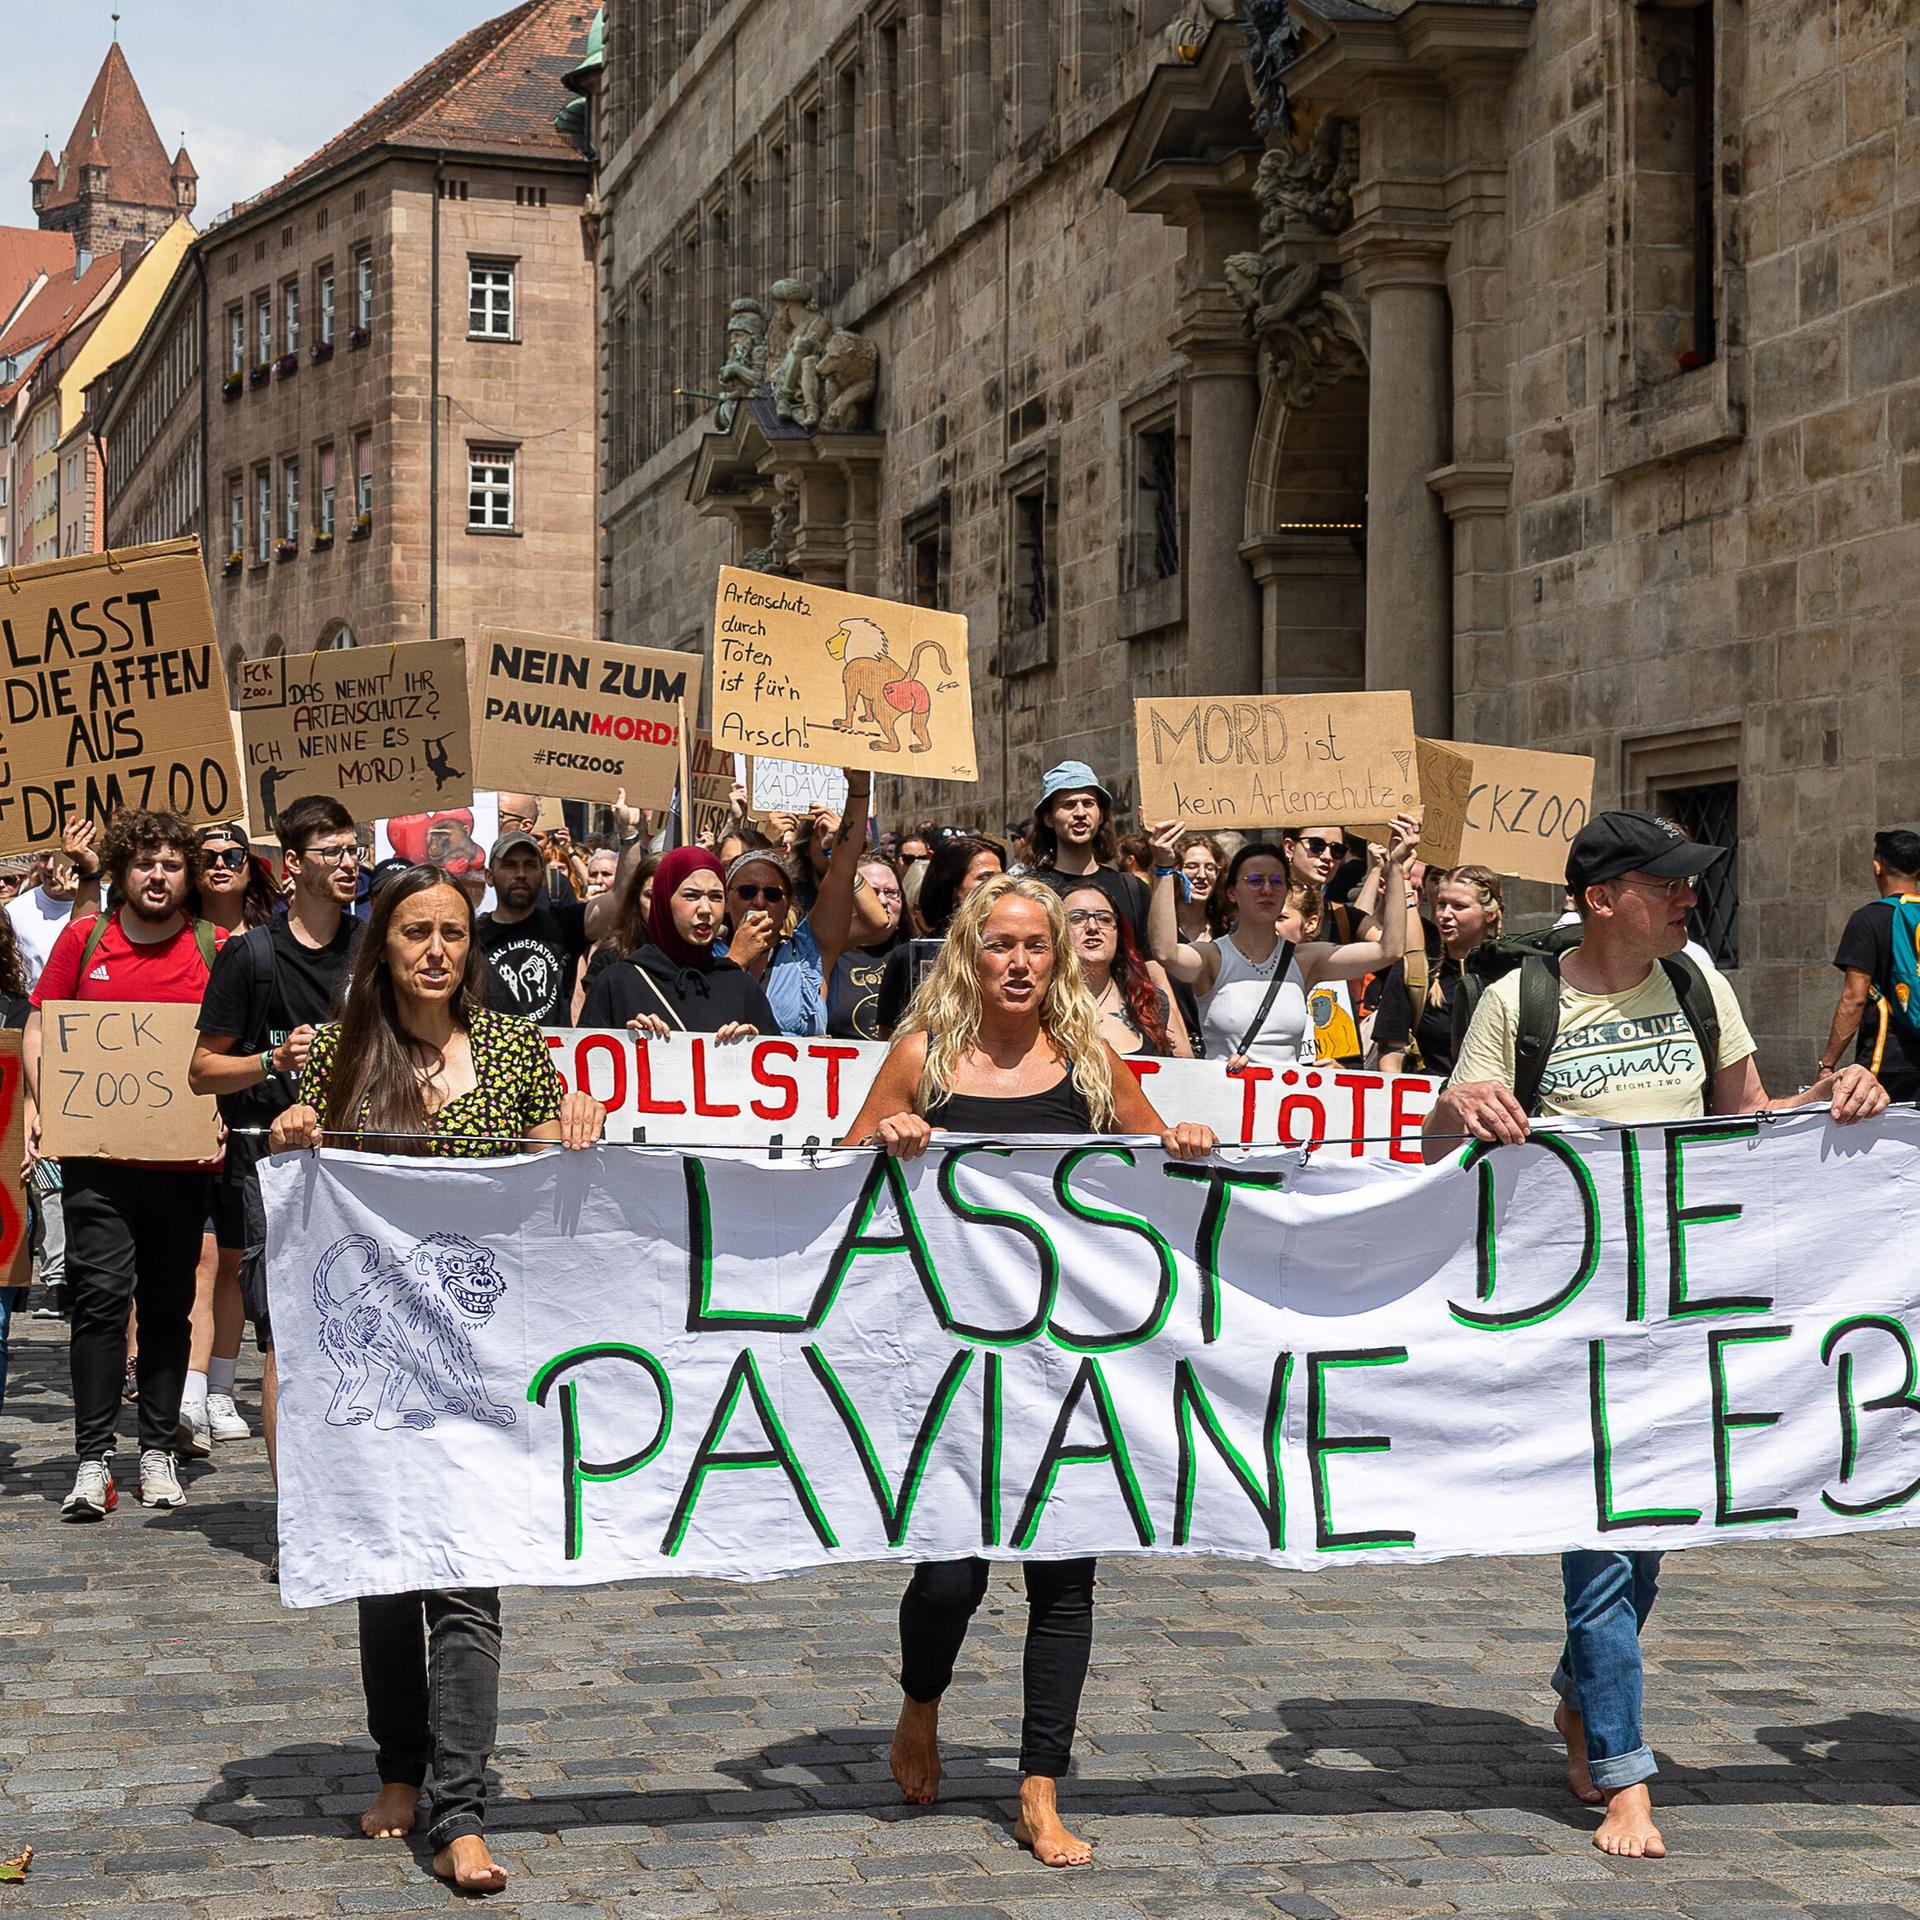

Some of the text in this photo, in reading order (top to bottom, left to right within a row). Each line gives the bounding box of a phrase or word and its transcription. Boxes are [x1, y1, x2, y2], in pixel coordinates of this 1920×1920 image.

[723, 582, 812, 616] Artenschutz
[2, 589, 161, 668] LASST
[721, 614, 767, 636] durch
[721, 638, 773, 666] Töten
[4, 645, 211, 724] DIE AFFEN
[243, 663, 274, 683] FCK
[288, 670, 435, 705] DAS NENNT IHR
[489, 643, 687, 703] NEIN ZUM
[719, 671, 744, 692] ist
[293, 691, 441, 732] ARTENSCHUTZ?
[485, 697, 680, 747] PAVIANMORD!
[721, 711, 810, 749] Arsch!
[66, 708, 144, 767] AUS
[248, 726, 410, 766] ICH NENNE ES
[1150, 703, 1346, 765] MORD ist
[532, 748, 625, 776] #FCKZOOS
[1173, 781, 1236, 817] kein
[507, 939, 559, 972] LIBERATION
[58, 1012, 163, 1052] FCK
[58, 1069, 173, 1119] ZOOS
[1554, 1093, 1576, 1104] ONE
[1616, 1080, 1652, 1092] EIGHT
[1658, 1078, 1682, 1088] TWO
[684, 1126, 1776, 1352] LASST DIE
[528, 1342, 1416, 1562] PAVIANE
